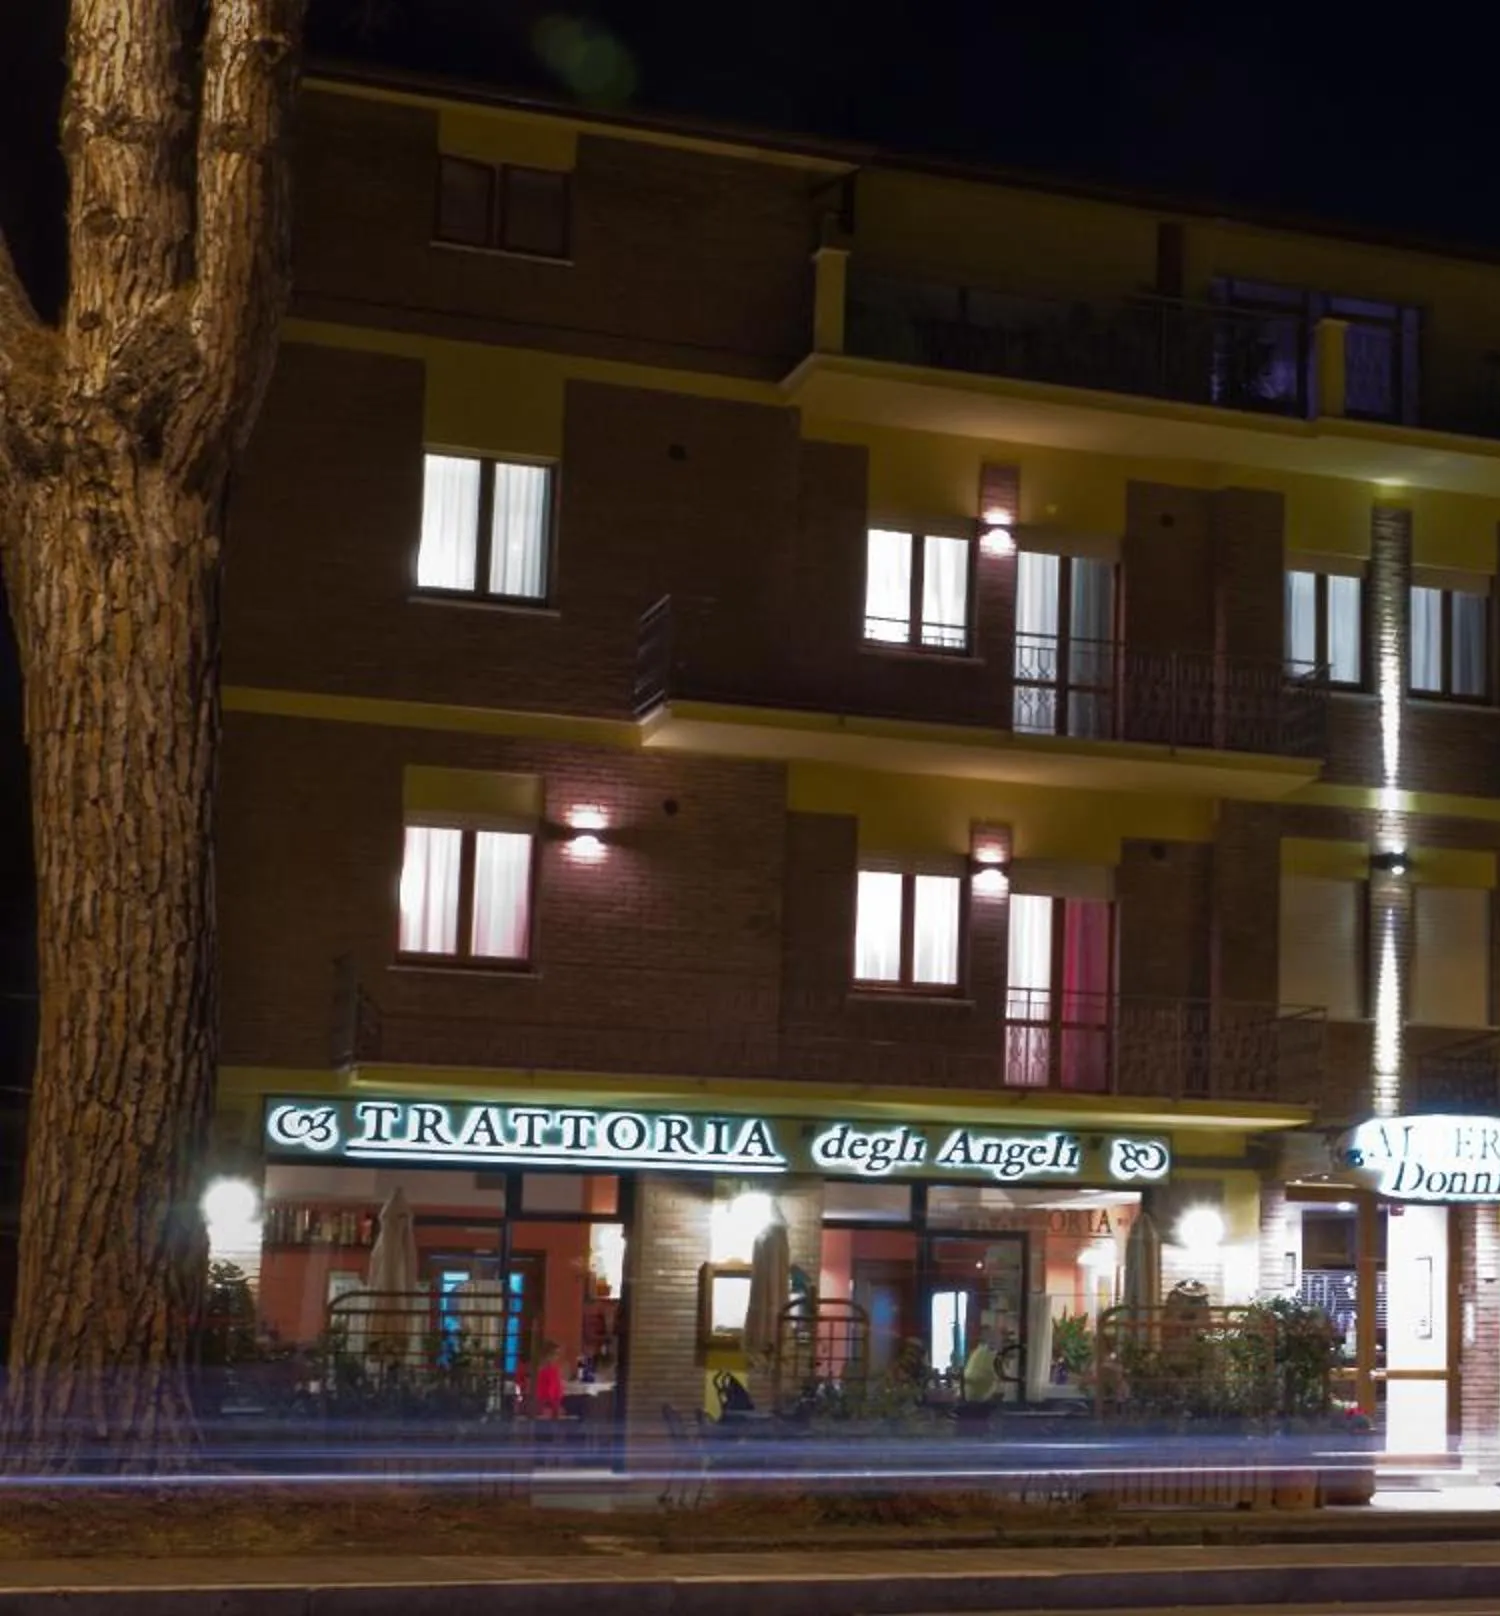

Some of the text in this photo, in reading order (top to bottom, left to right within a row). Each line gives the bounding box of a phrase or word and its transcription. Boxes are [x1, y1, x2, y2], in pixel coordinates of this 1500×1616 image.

[360, 1104, 1079, 1176] TRATTORIA degli Angeli
